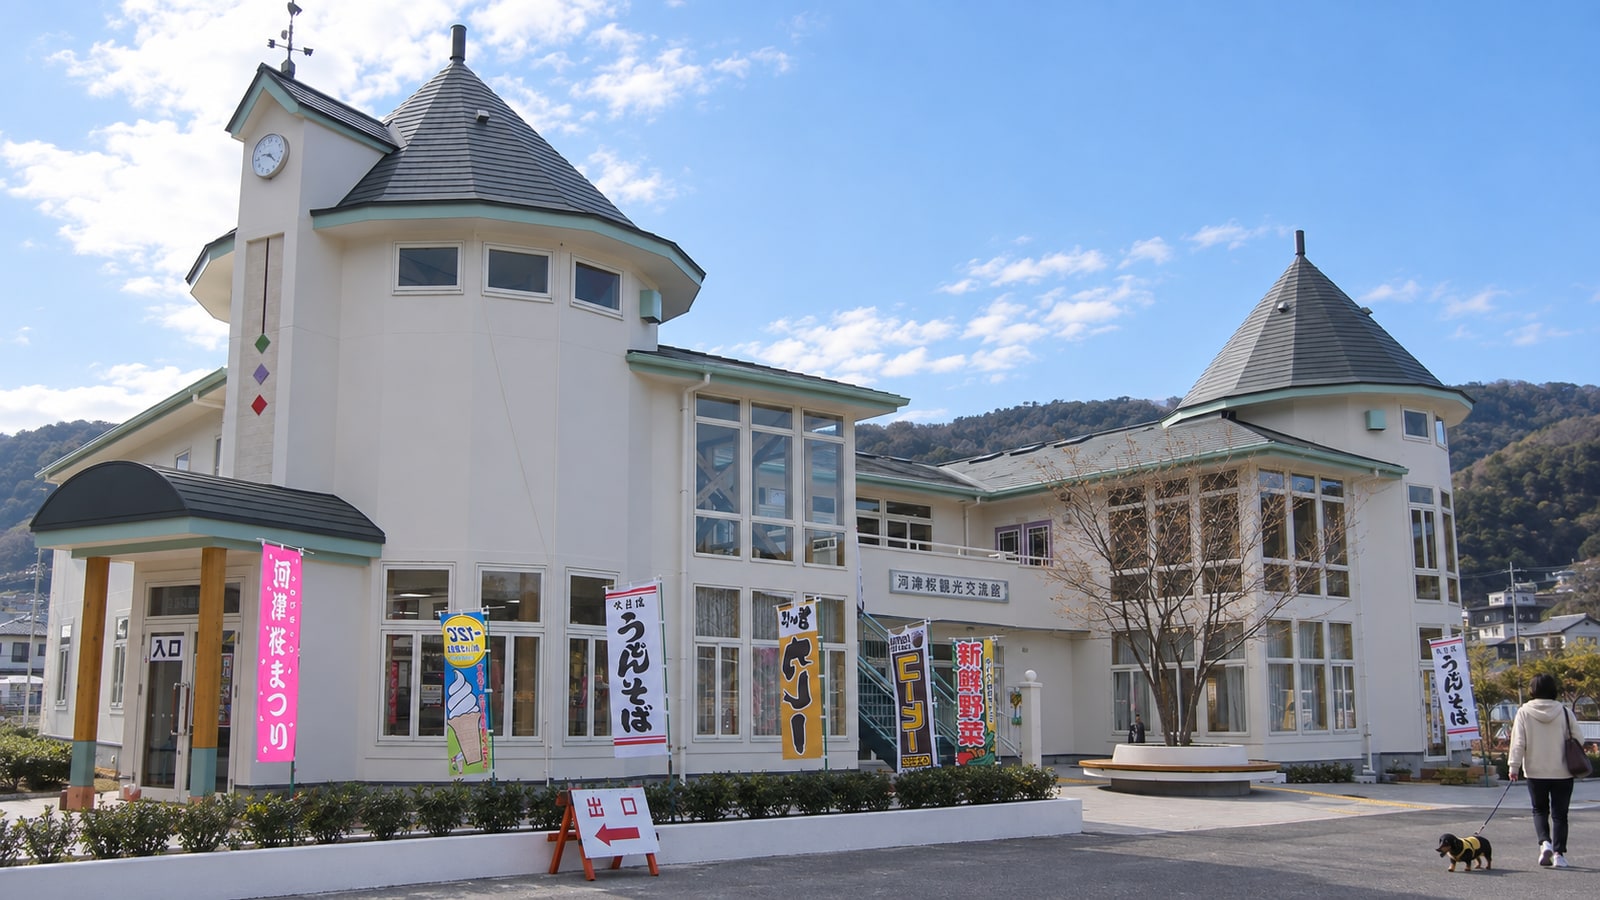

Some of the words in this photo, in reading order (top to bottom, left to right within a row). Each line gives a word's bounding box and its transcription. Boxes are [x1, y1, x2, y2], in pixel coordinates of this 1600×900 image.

[152, 639, 182, 658] 入口
[267, 559, 291, 751] 河津桜まつり
[616, 611, 653, 734] うどんそば
[957, 641, 985, 747] 新鮮野菜
[586, 796, 638, 818] 出口
